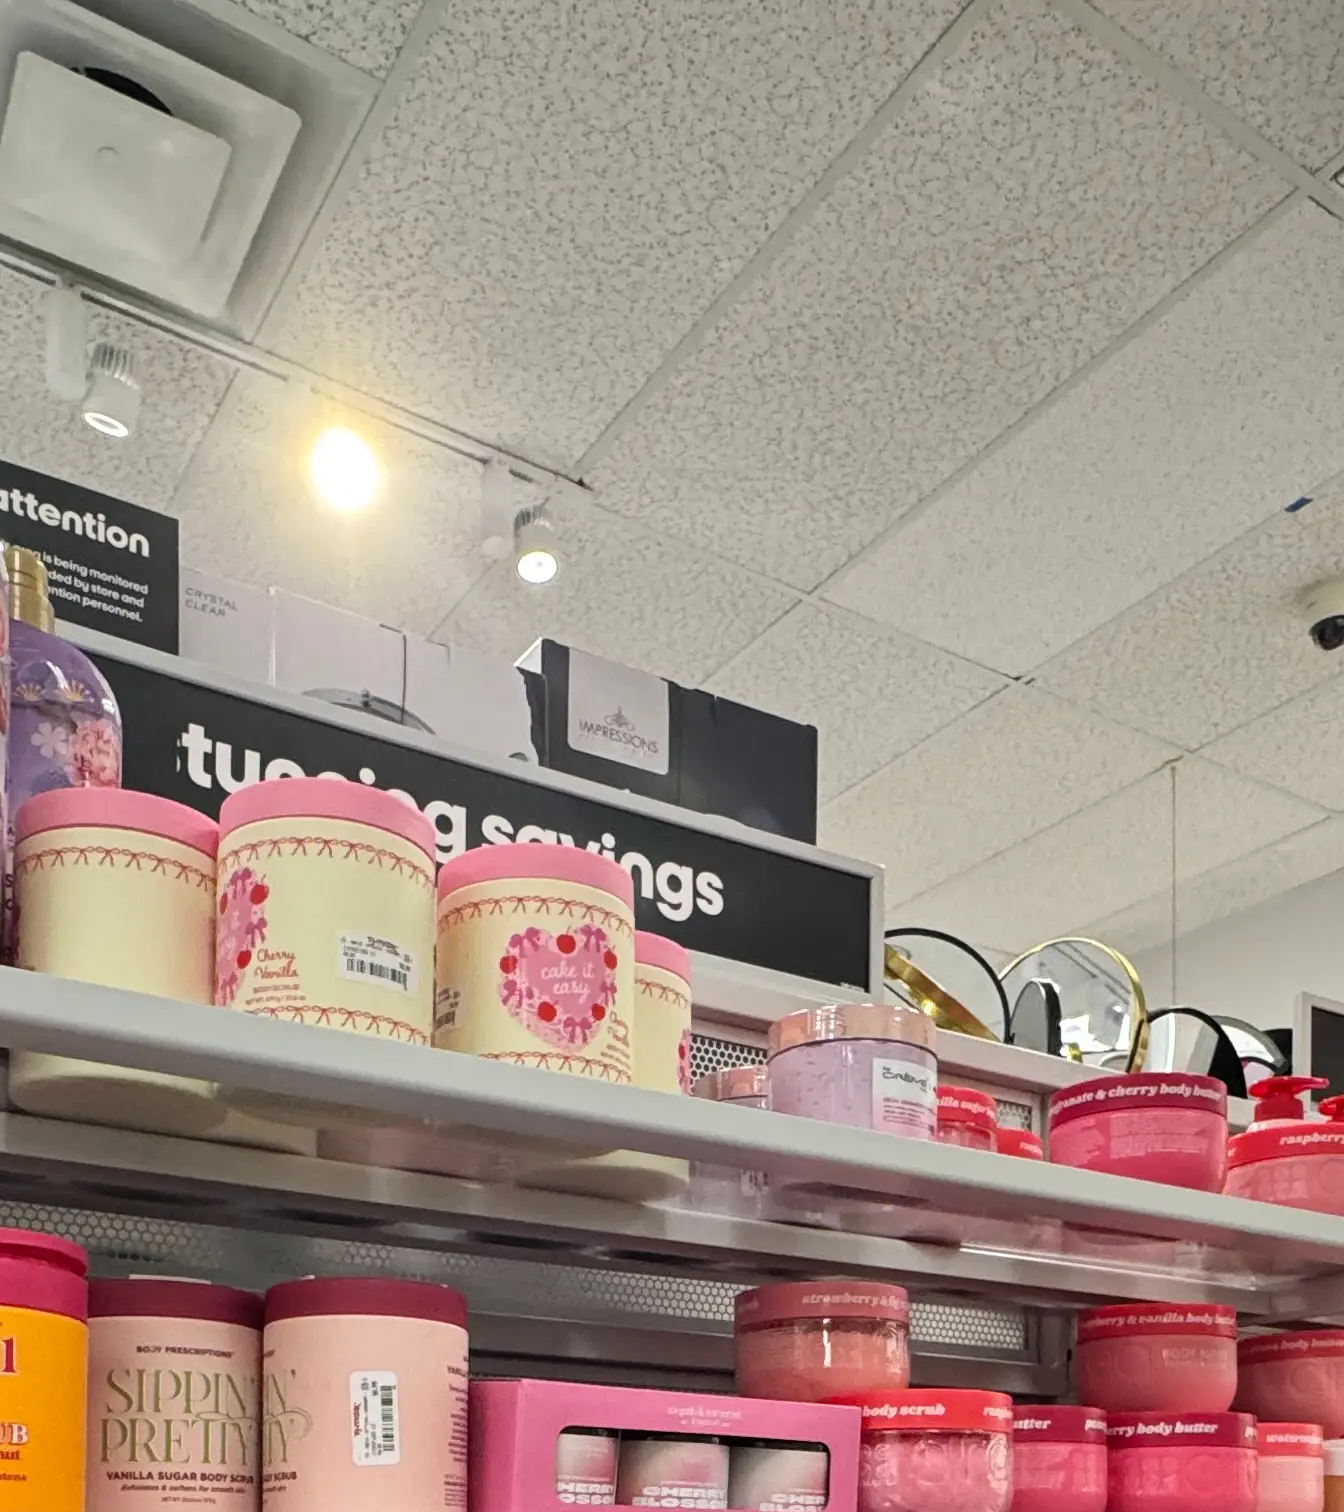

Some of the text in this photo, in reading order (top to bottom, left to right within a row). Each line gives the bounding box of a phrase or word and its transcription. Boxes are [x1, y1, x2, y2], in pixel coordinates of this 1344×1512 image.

[42, 550, 53, 564] is
[53, 553, 88, 579] being
[88, 566, 150, 595] monitored
[73, 576, 90, 594] by
[90, 581, 120, 601] store
[121, 590, 145, 609] and
[184, 585, 239, 613] CRYSTAL
[81, 595, 144, 623] personnel.
[184, 599, 227, 619] CLEAR
[578, 716, 660, 756] IMPRESSIONS
[256, 948, 297, 966] Cherry
[541, 959, 596, 982] cake it
[552, 980, 591, 1000] easy
[1138, 1310, 1216, 1328] vanilla body
[861, 1403, 946, 1420] body scrub
[99, 1411, 259, 1467] PRETTY
[1135, 1420, 1219, 1438] body butter
[105, 1470, 228, 1484] VANILLA SUGAR BODY
